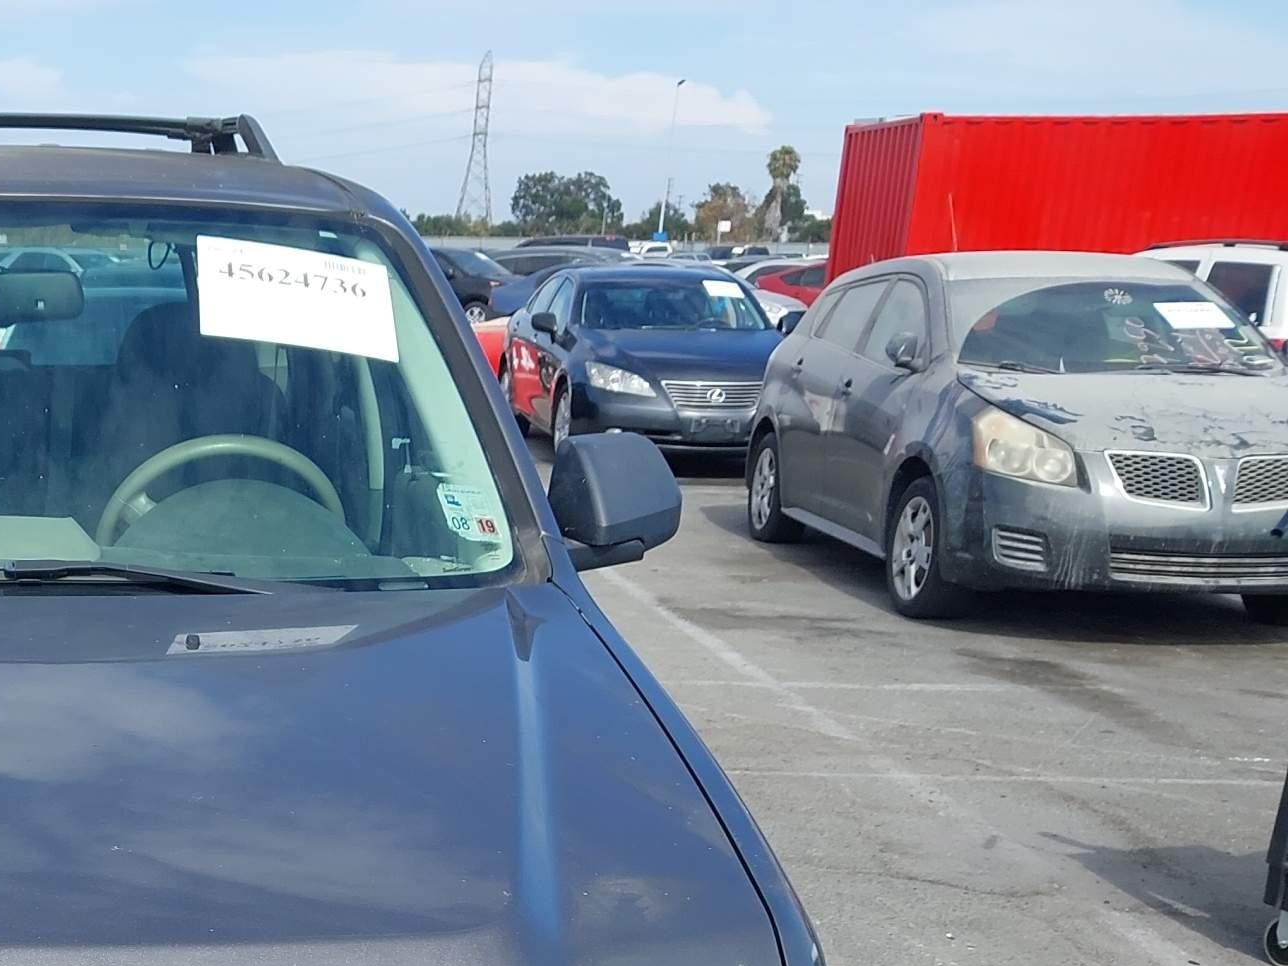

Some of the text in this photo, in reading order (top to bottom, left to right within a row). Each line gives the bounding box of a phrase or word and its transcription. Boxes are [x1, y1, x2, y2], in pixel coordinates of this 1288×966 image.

[218, 262, 367, 298] 45624736
[451, 516, 496, 534] 08 19
